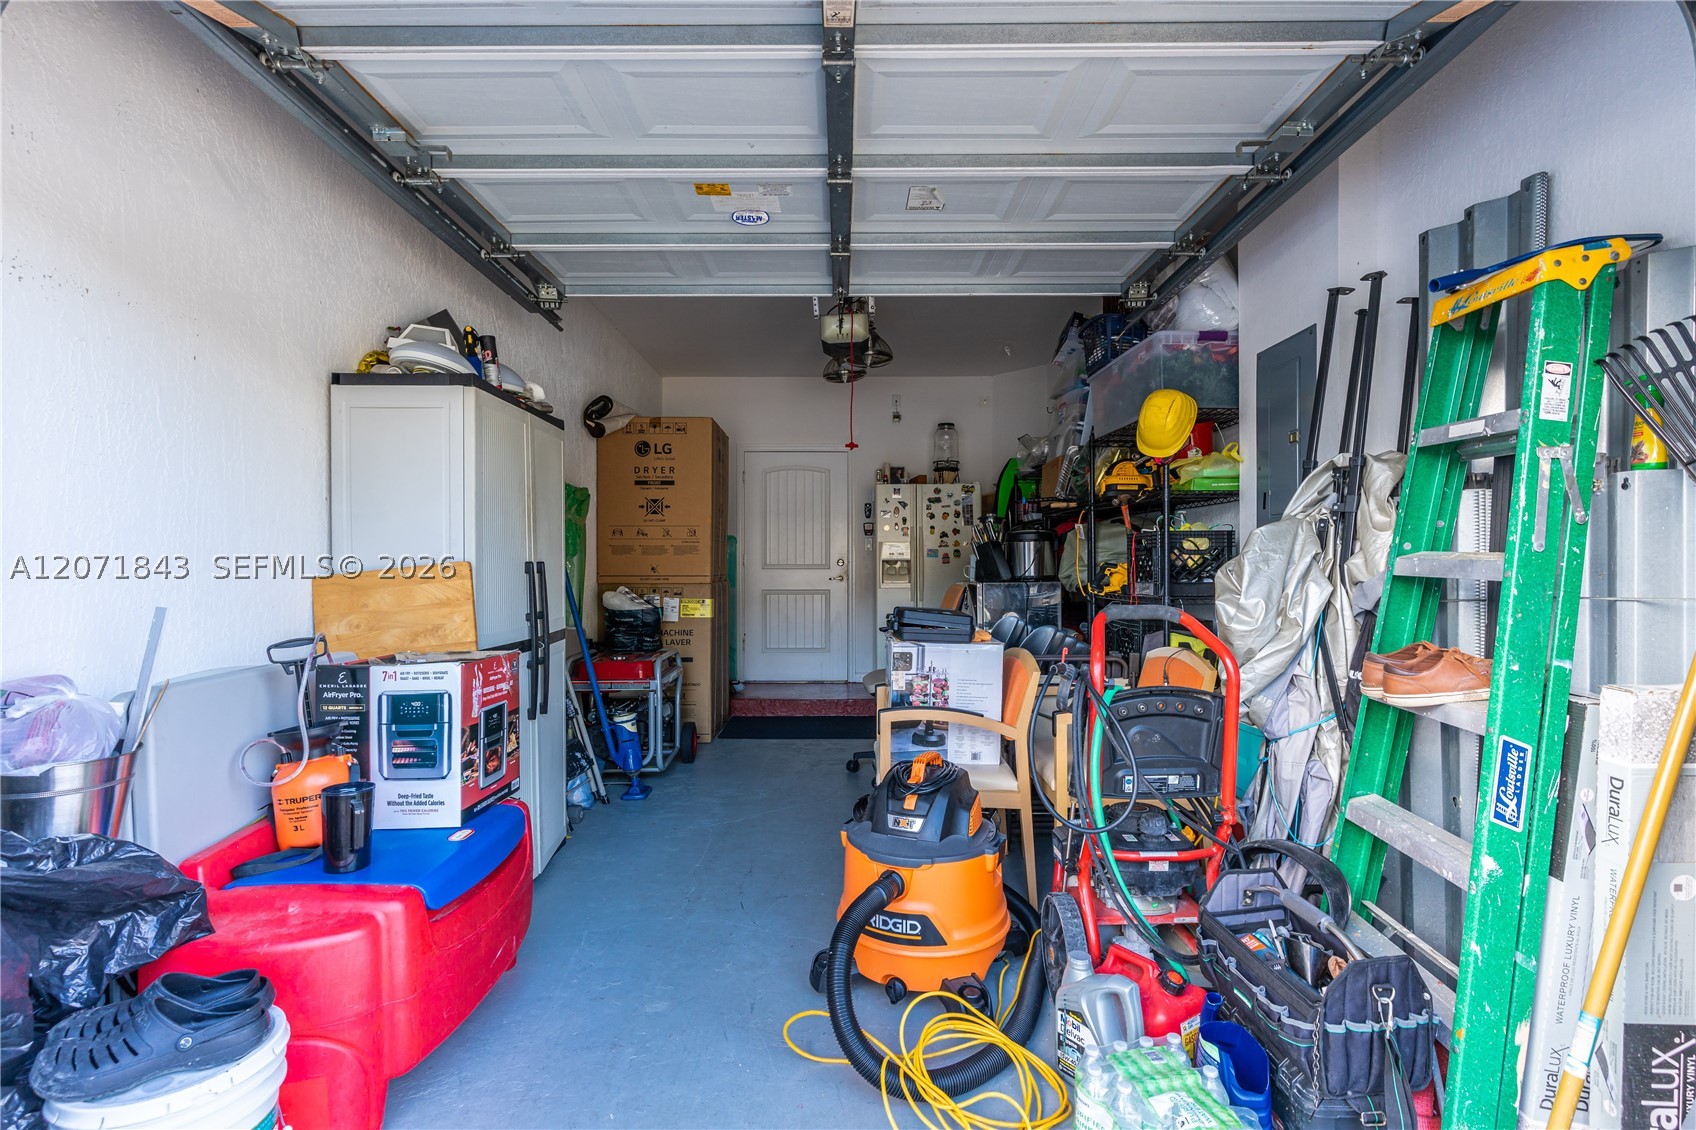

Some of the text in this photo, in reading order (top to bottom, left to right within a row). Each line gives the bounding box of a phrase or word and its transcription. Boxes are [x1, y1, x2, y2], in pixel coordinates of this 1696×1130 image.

[654, 443, 672, 454] LG
[634, 466, 675, 474] DRYER
[1499, 748, 1518, 818] Louisville
[1515, 752, 1524, 793] LADDER
[284, 794, 322, 805] TRUPER
[870, 914, 921, 935] RIDGID
[1556, 896, 1580, 1025] WATERPROOF LUXURY VINYL
[1686, 1054, 1695, 1082] VINYL
